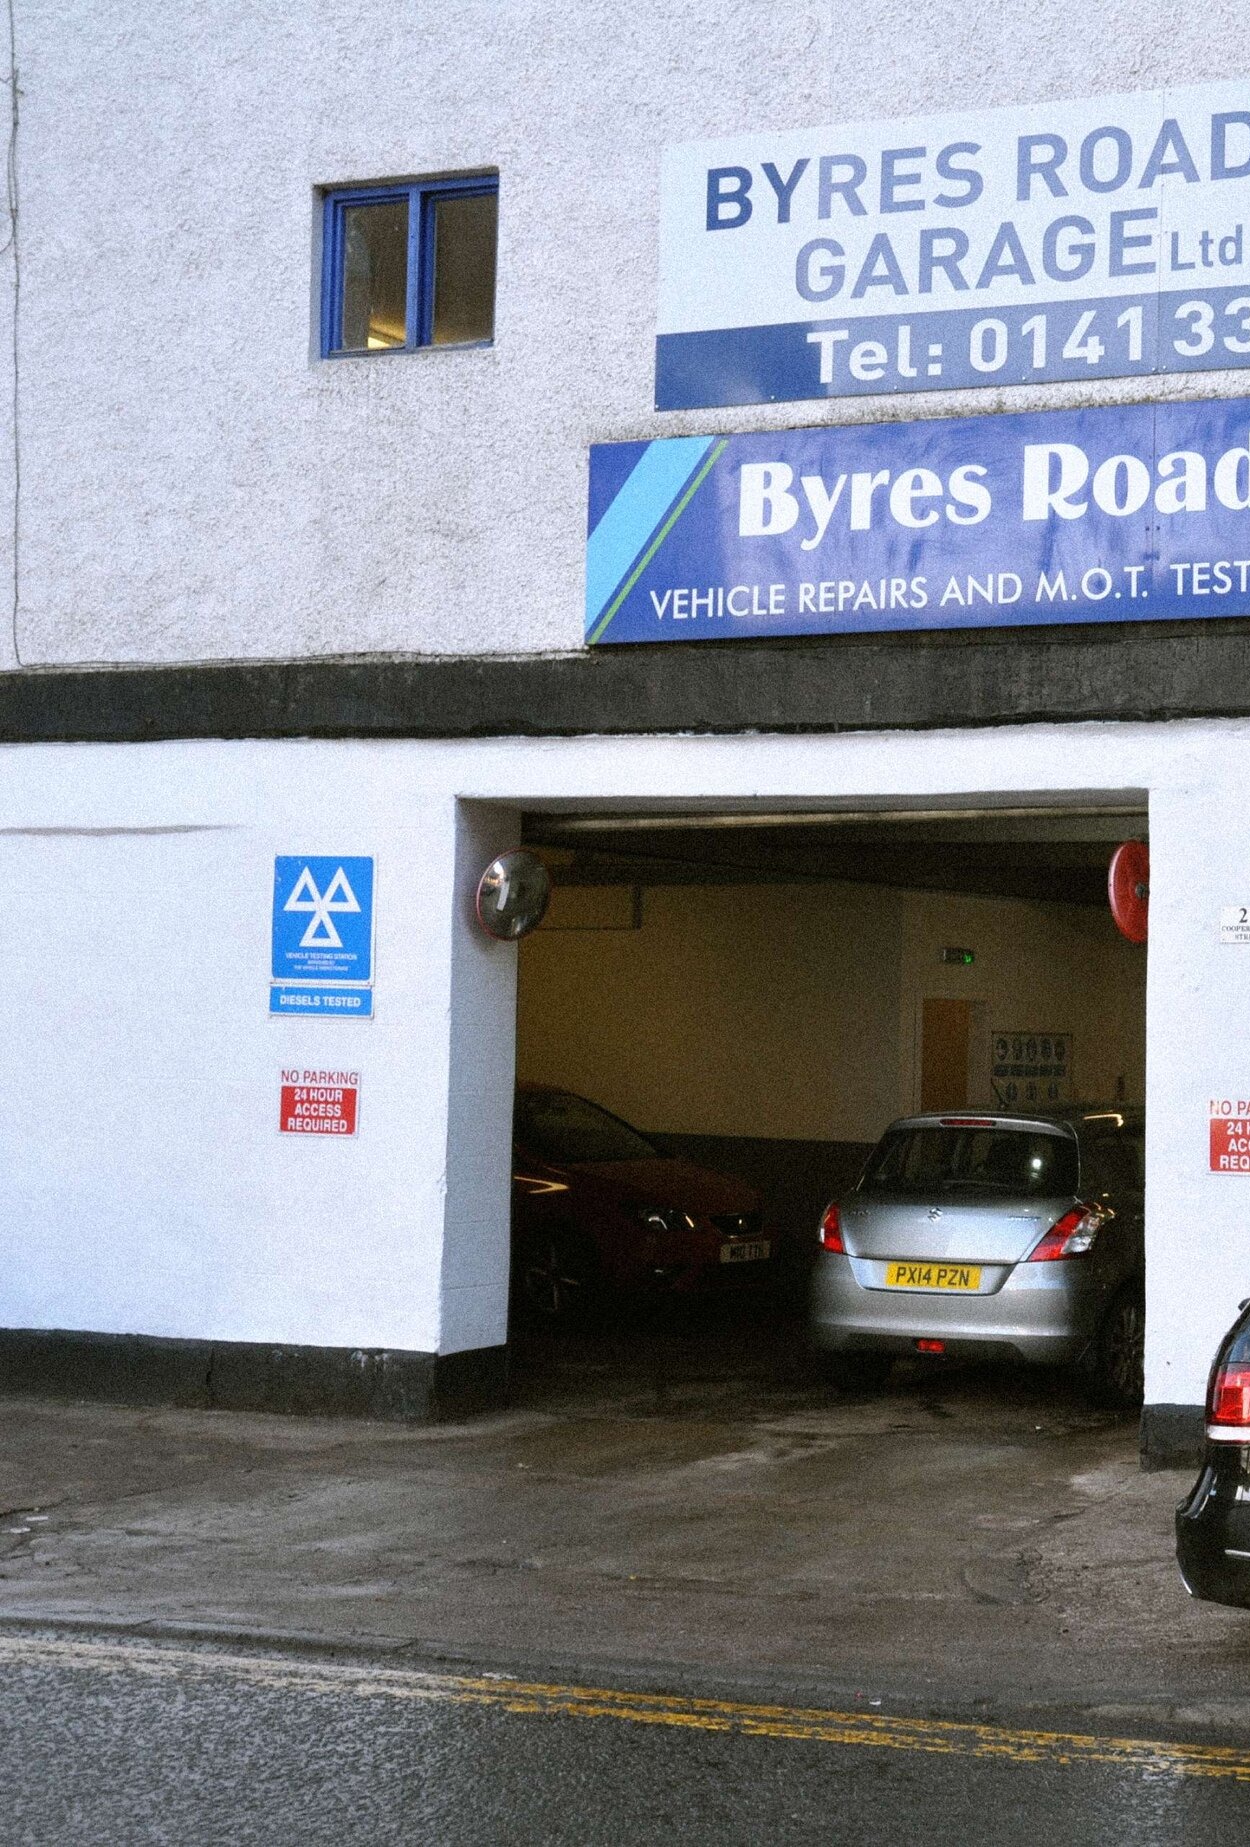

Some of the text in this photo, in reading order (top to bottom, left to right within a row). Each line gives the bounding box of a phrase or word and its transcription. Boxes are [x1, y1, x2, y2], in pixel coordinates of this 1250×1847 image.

[706, 142, 984, 231] BYRES
[796, 208, 1243, 302] GARAGE Ltd
[806, 325, 942, 384] Tel:
[969, 307, 1143, 372] 0141
[739, 461, 991, 550] Byres
[650, 584, 785, 620] VEHICLE
[799, 576, 928, 612] REPAIRS
[940, 573, 1021, 607] AND
[1036, 566, 1148, 602] M.O.T.
[333, 953, 357, 961] STATION
[280, 994, 361, 1008] DIESELS TESTED
[281, 1070, 358, 1085] NO PARKING
[294, 1088, 343, 1102] 24 HOUR
[294, 1103, 341, 1117] ACCESS
[1210, 1100, 1232, 1115] NO
[287, 1117, 347, 1132] REQUIRED
[1226, 1121, 1242, 1135] 24
[896, 1265, 970, 1287] PX14 PZN
